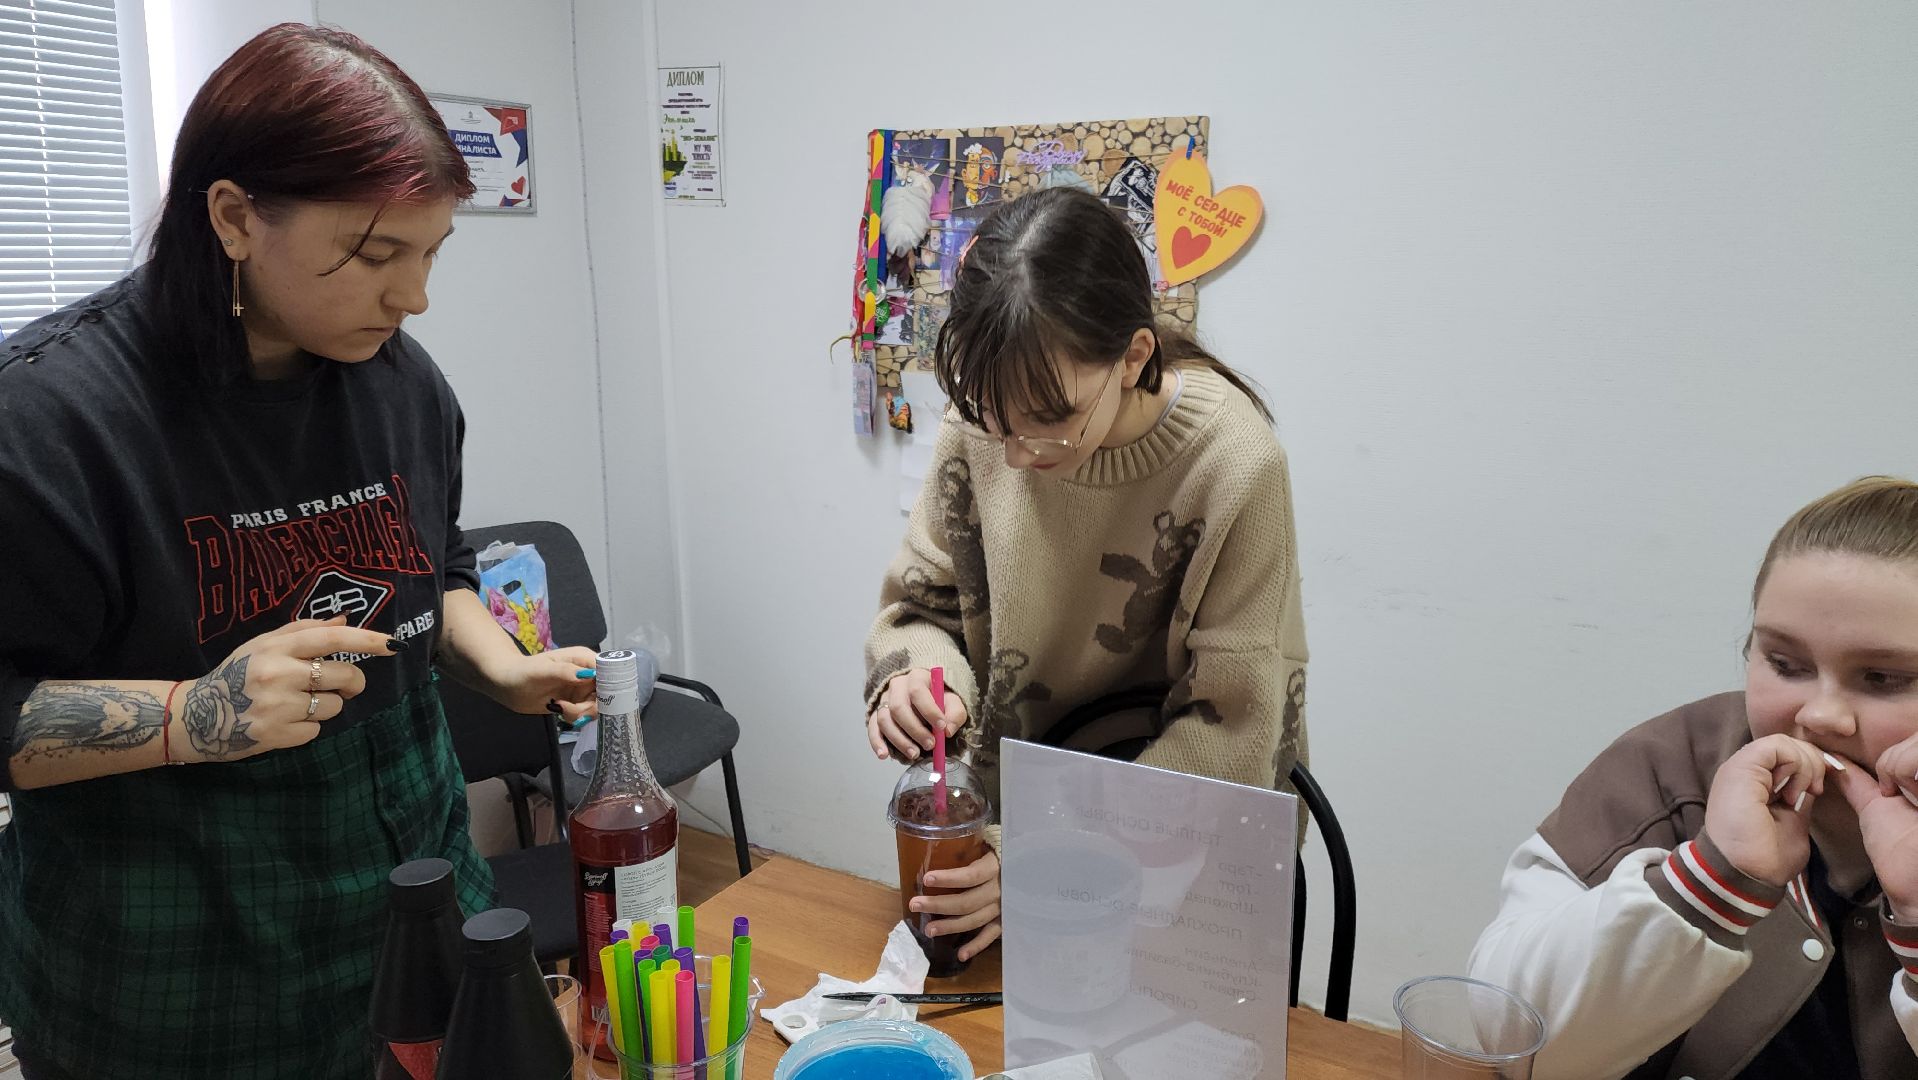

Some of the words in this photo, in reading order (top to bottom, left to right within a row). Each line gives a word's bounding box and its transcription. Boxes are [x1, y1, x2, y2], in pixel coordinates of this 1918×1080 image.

[667, 71, 705, 88] ДИПЛОМ
[454, 133, 491, 144] ДИПЛОМ
[455, 144, 497, 155] ИНАЛИСТА
[1165, 179, 1194, 201] МОЁ
[1193, 195, 1247, 228] СЕРДЦЕ
[231, 507, 289, 530] PARIS
[297, 482, 387, 518] FRANCE
